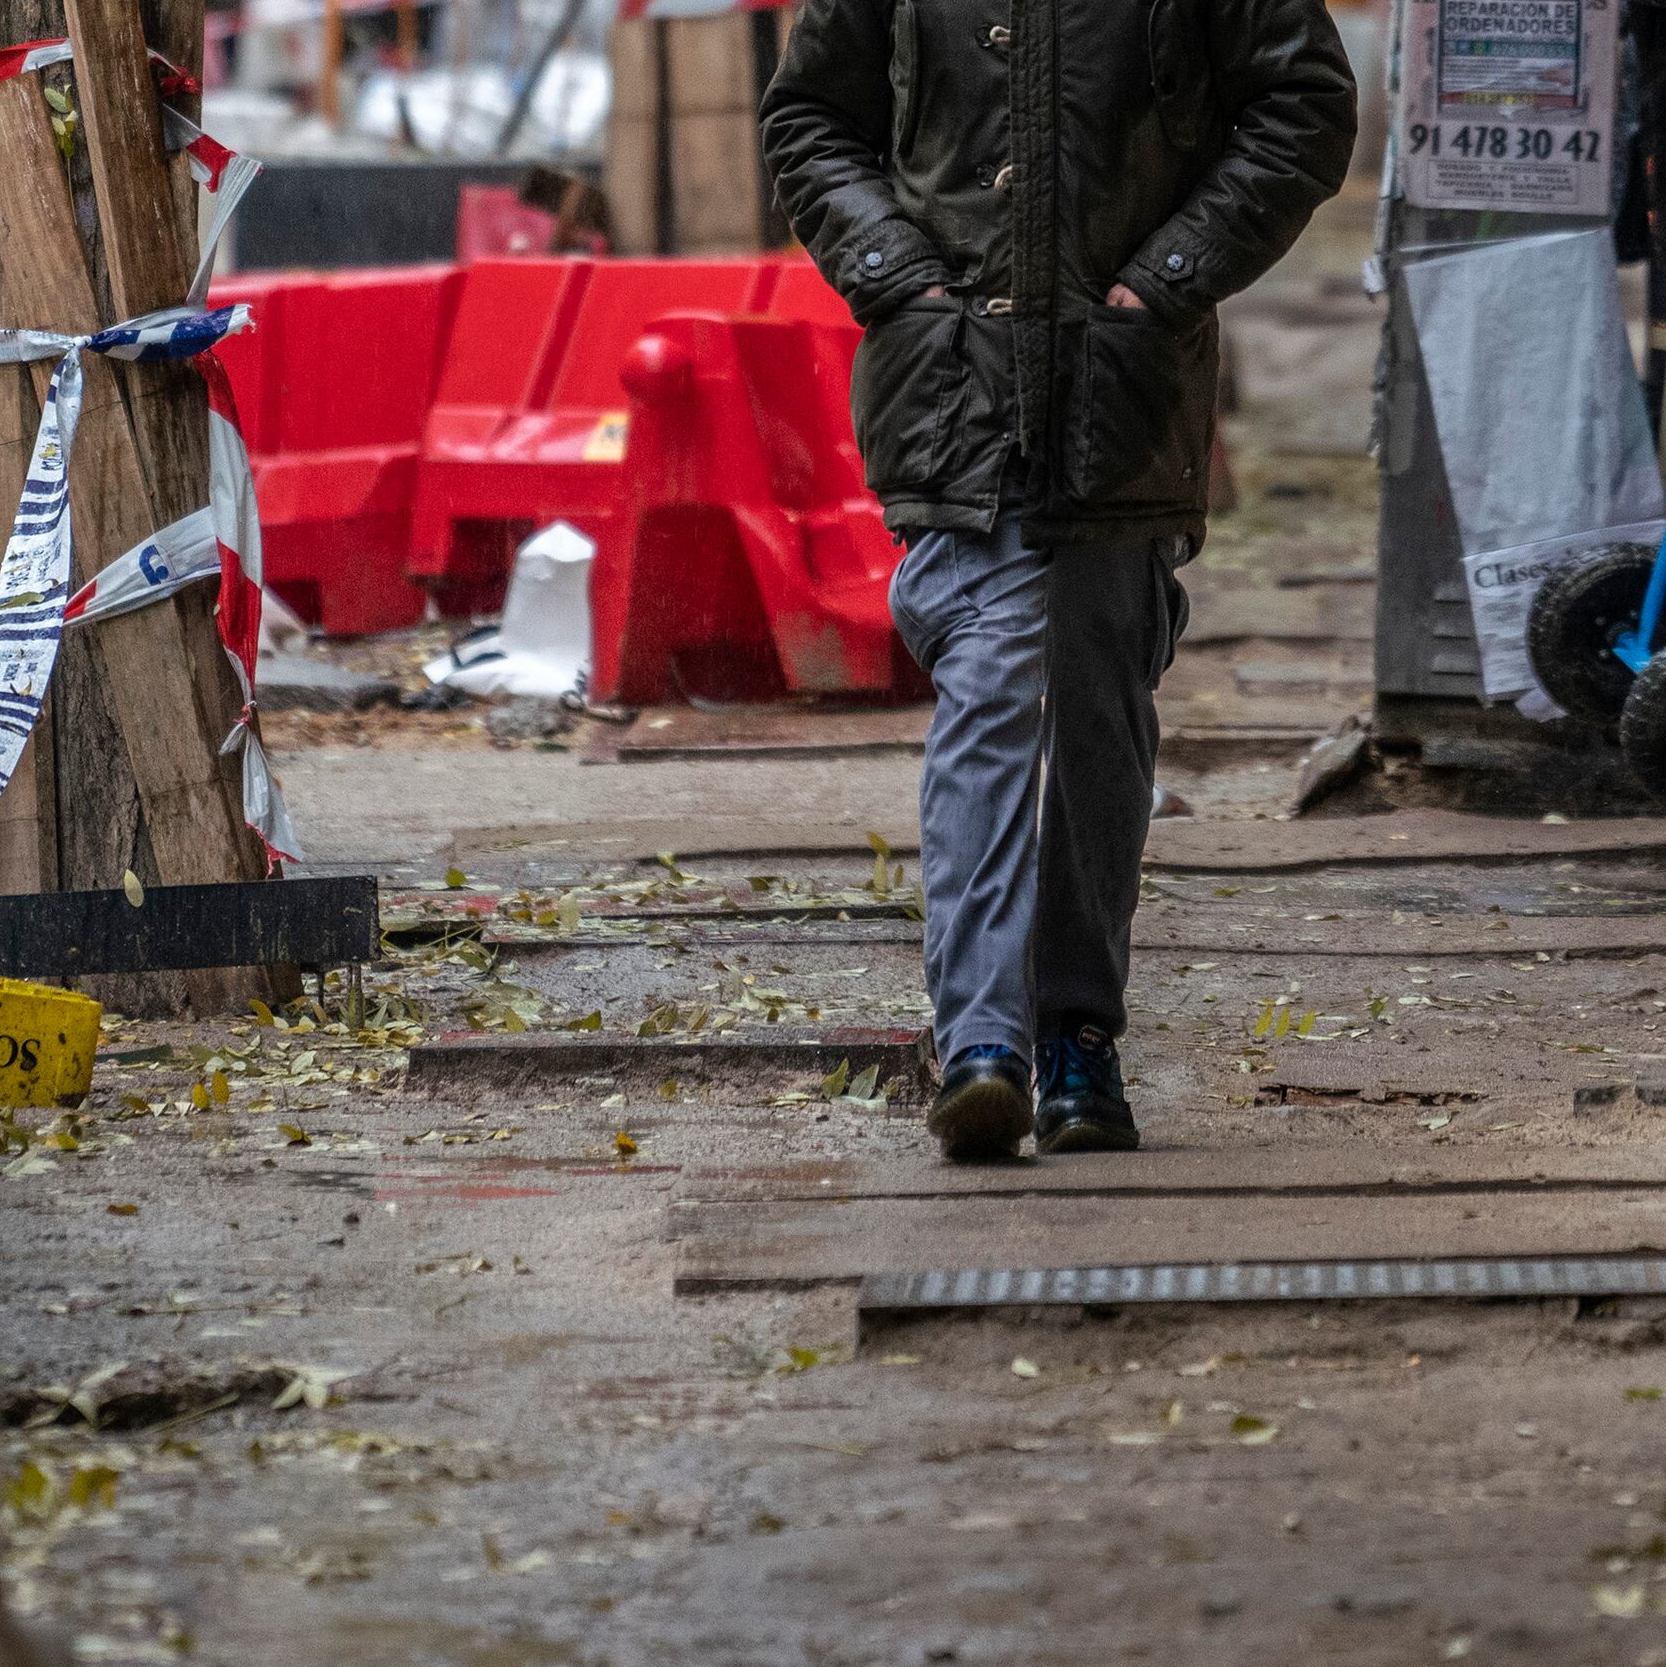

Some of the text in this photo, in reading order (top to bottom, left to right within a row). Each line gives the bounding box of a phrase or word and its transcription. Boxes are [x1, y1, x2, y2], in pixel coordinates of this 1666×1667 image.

[1554, 3, 1575, 19] DE
[1443, 16, 1576, 34] ORDENADORES
[1409, 124, 1601, 163] 91 478 30 42
[1474, 561, 1550, 589] Clases
